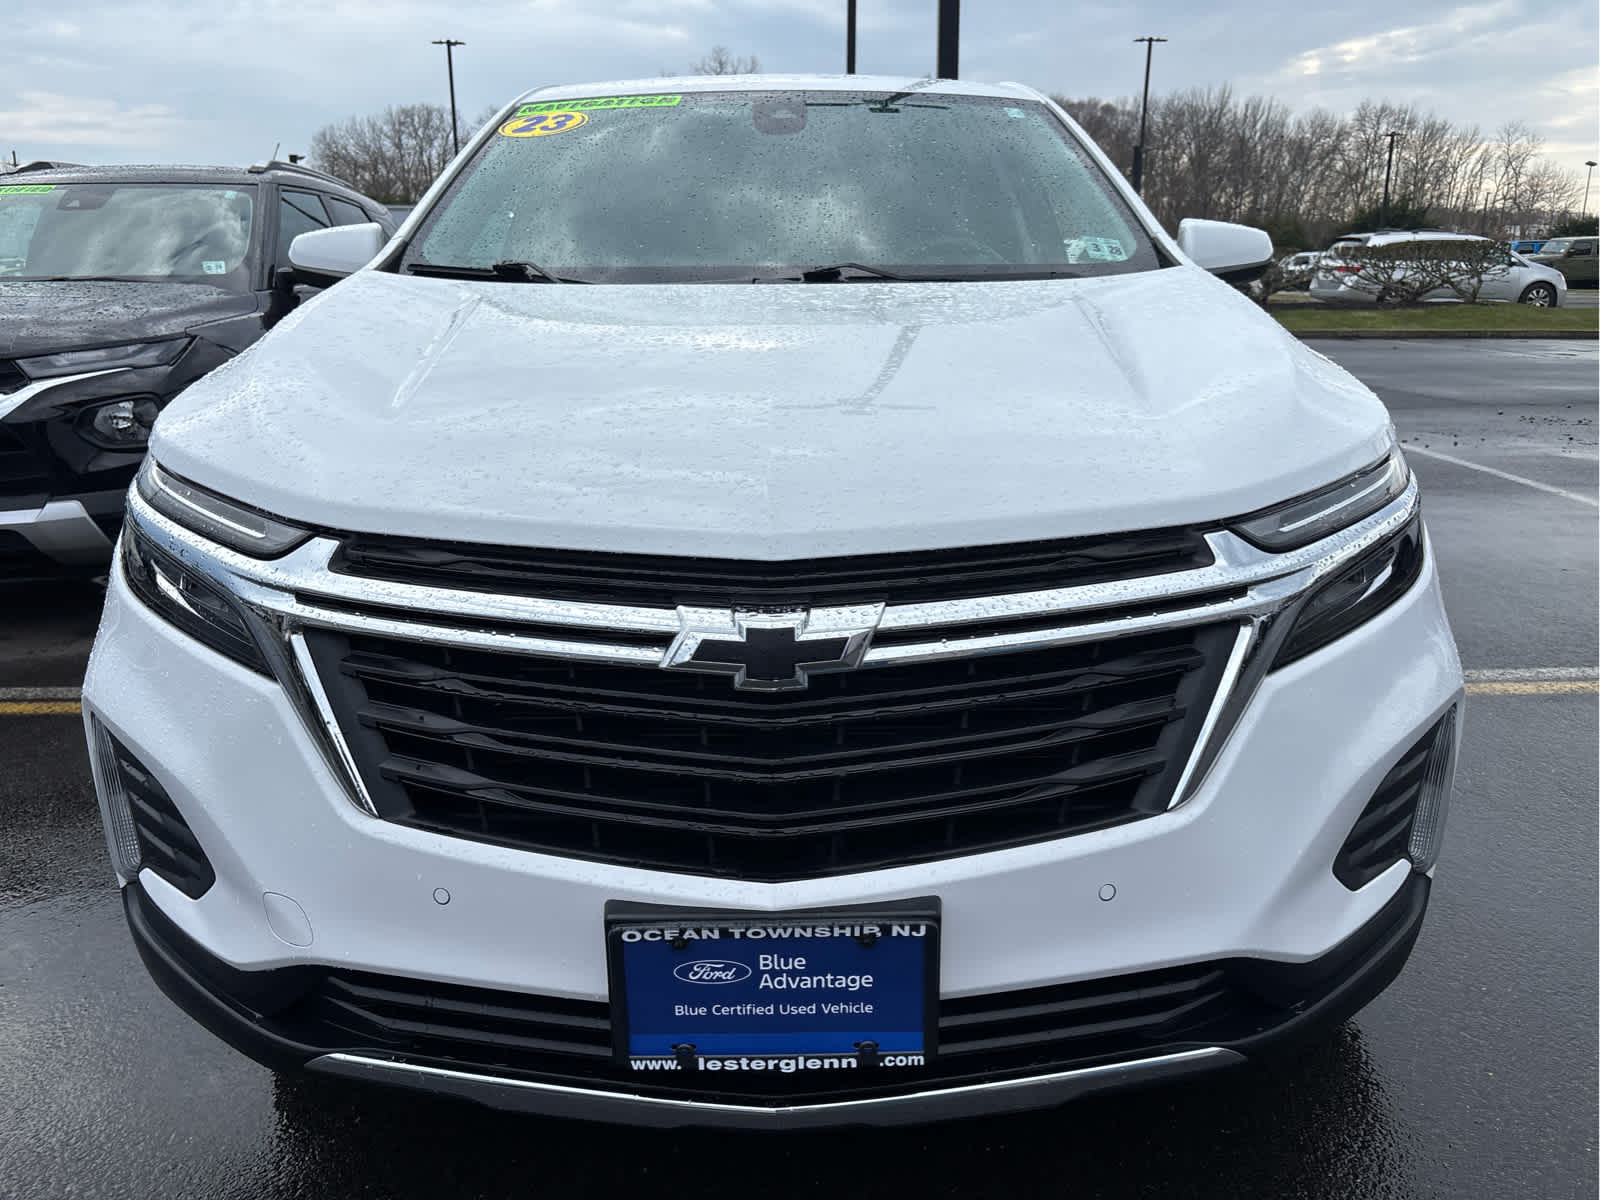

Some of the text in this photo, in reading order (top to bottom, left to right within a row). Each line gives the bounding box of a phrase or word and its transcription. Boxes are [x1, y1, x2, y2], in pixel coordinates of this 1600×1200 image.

[520, 96, 676, 113] NAVIGATION
[511, 113, 575, 133] 23
[621, 927, 720, 943] OCEAN
[891, 924, 927, 937] NJ
[759, 954, 807, 970] Blue
[688, 962, 736, 982] Ford
[759, 972, 873, 991] Advantage
[674, 1002, 874, 1016] Blue Certified Used Vehicle
[631, 1054, 925, 1073] www. lesterglenn .com
